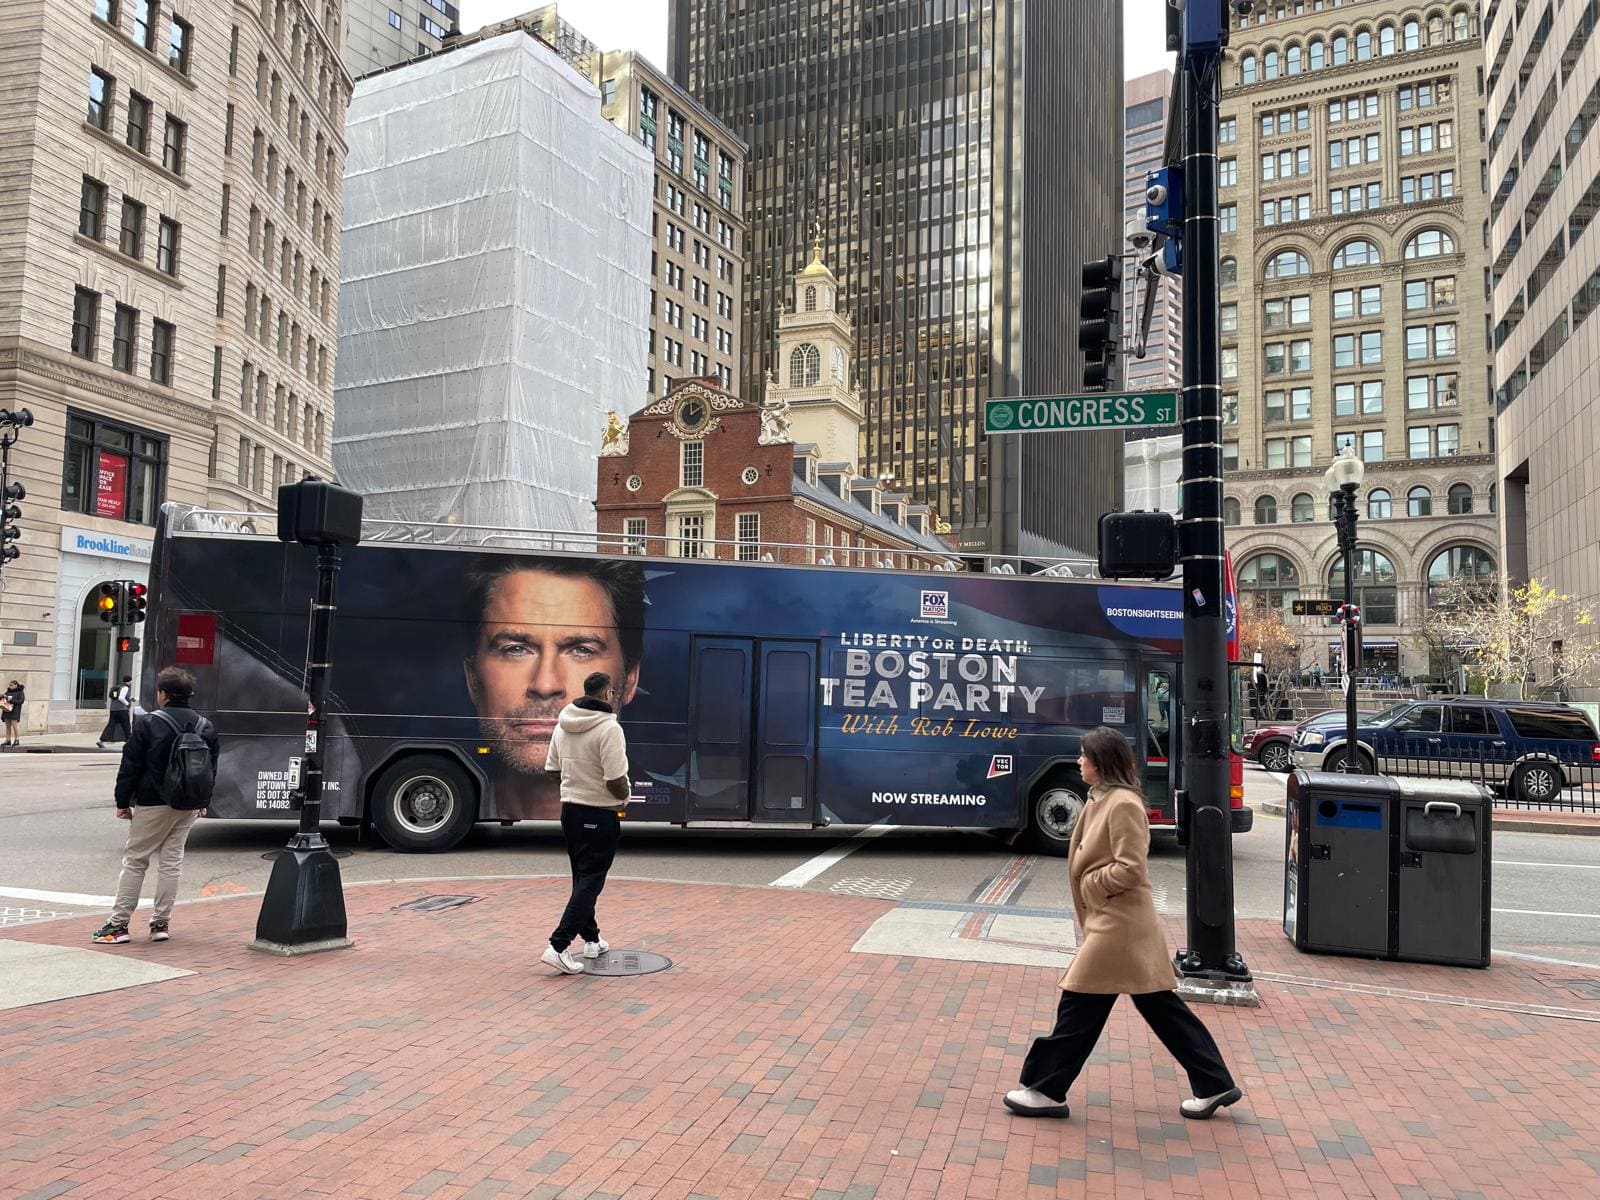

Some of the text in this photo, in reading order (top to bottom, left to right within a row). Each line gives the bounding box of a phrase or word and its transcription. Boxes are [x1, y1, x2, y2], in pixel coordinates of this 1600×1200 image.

[1018, 397, 1171, 428] CONGRESS ST
[923, 594, 945, 606] FOX
[841, 632, 1032, 654] LIBERTY OR DEATH:
[846, 648, 1018, 683] BOSTON
[820, 677, 1046, 714] TEA PARTY
[841, 713, 1019, 739] With Rob Lowe
[258, 771, 289, 780] OWNED B
[257, 781, 286, 790] UPTOWN
[256, 791, 266, 799] US
[267, 791, 281, 800] DOT
[871, 792, 986, 806] NOW STREAMING
[256, 800, 267, 809] MC
